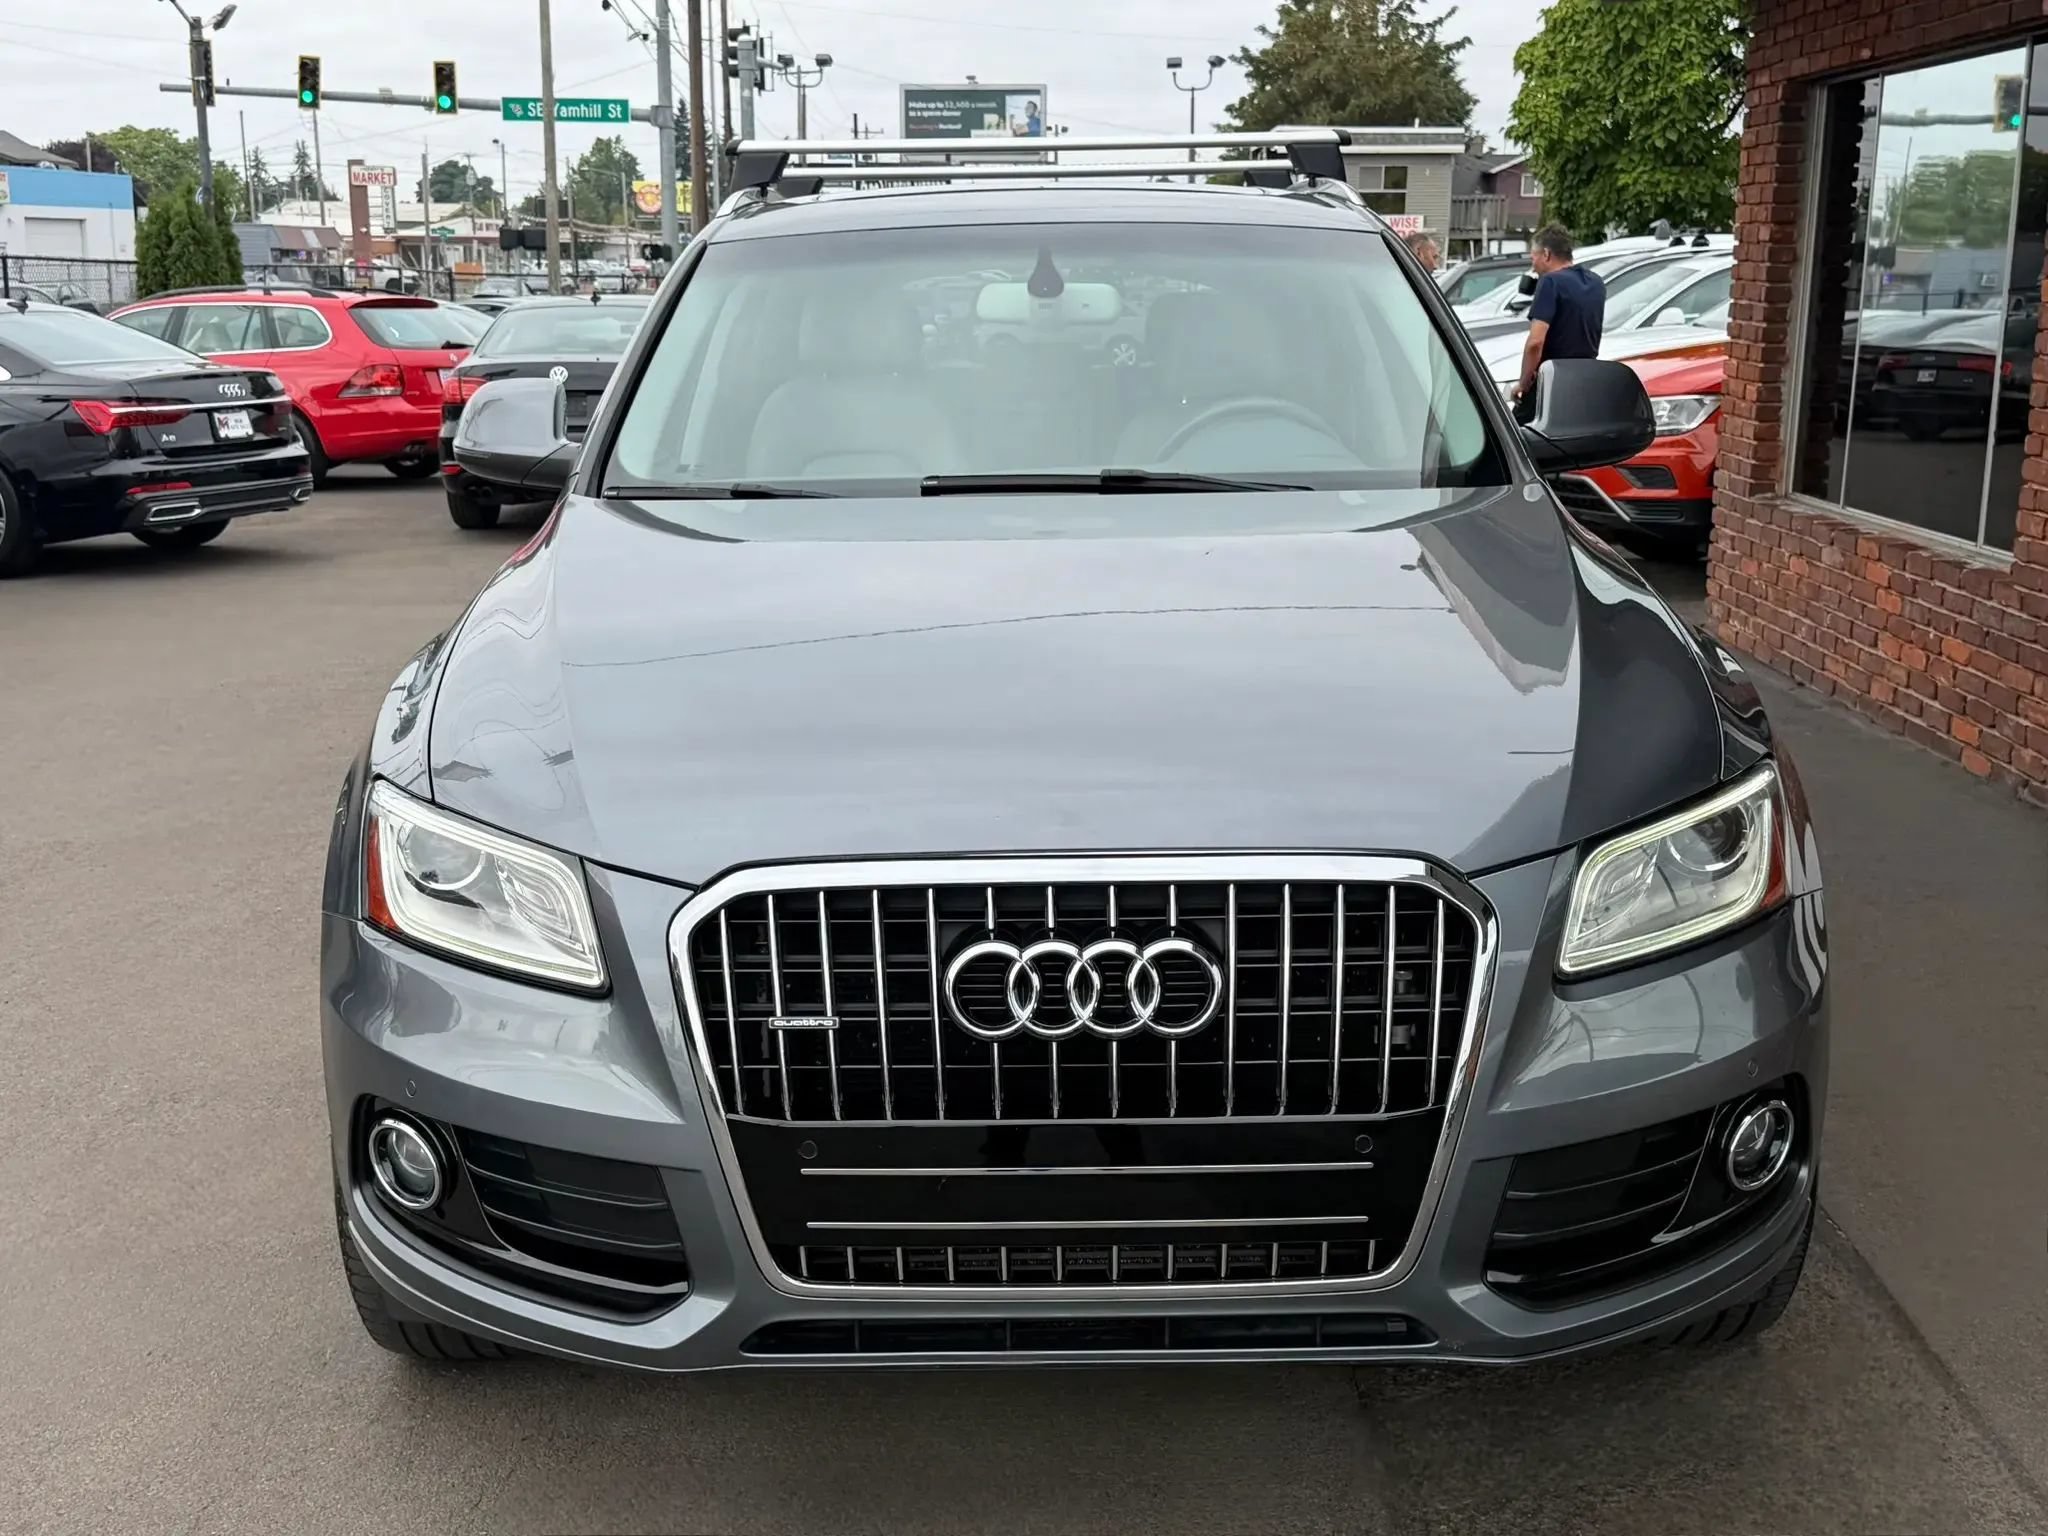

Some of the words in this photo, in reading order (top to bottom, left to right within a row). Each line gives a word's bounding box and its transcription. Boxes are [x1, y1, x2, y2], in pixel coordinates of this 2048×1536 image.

[528, 102, 544, 117] SE
[608, 104, 622, 118] St
[352, 172, 393, 185] MARKET
[1390, 216, 1419, 229] WISE
